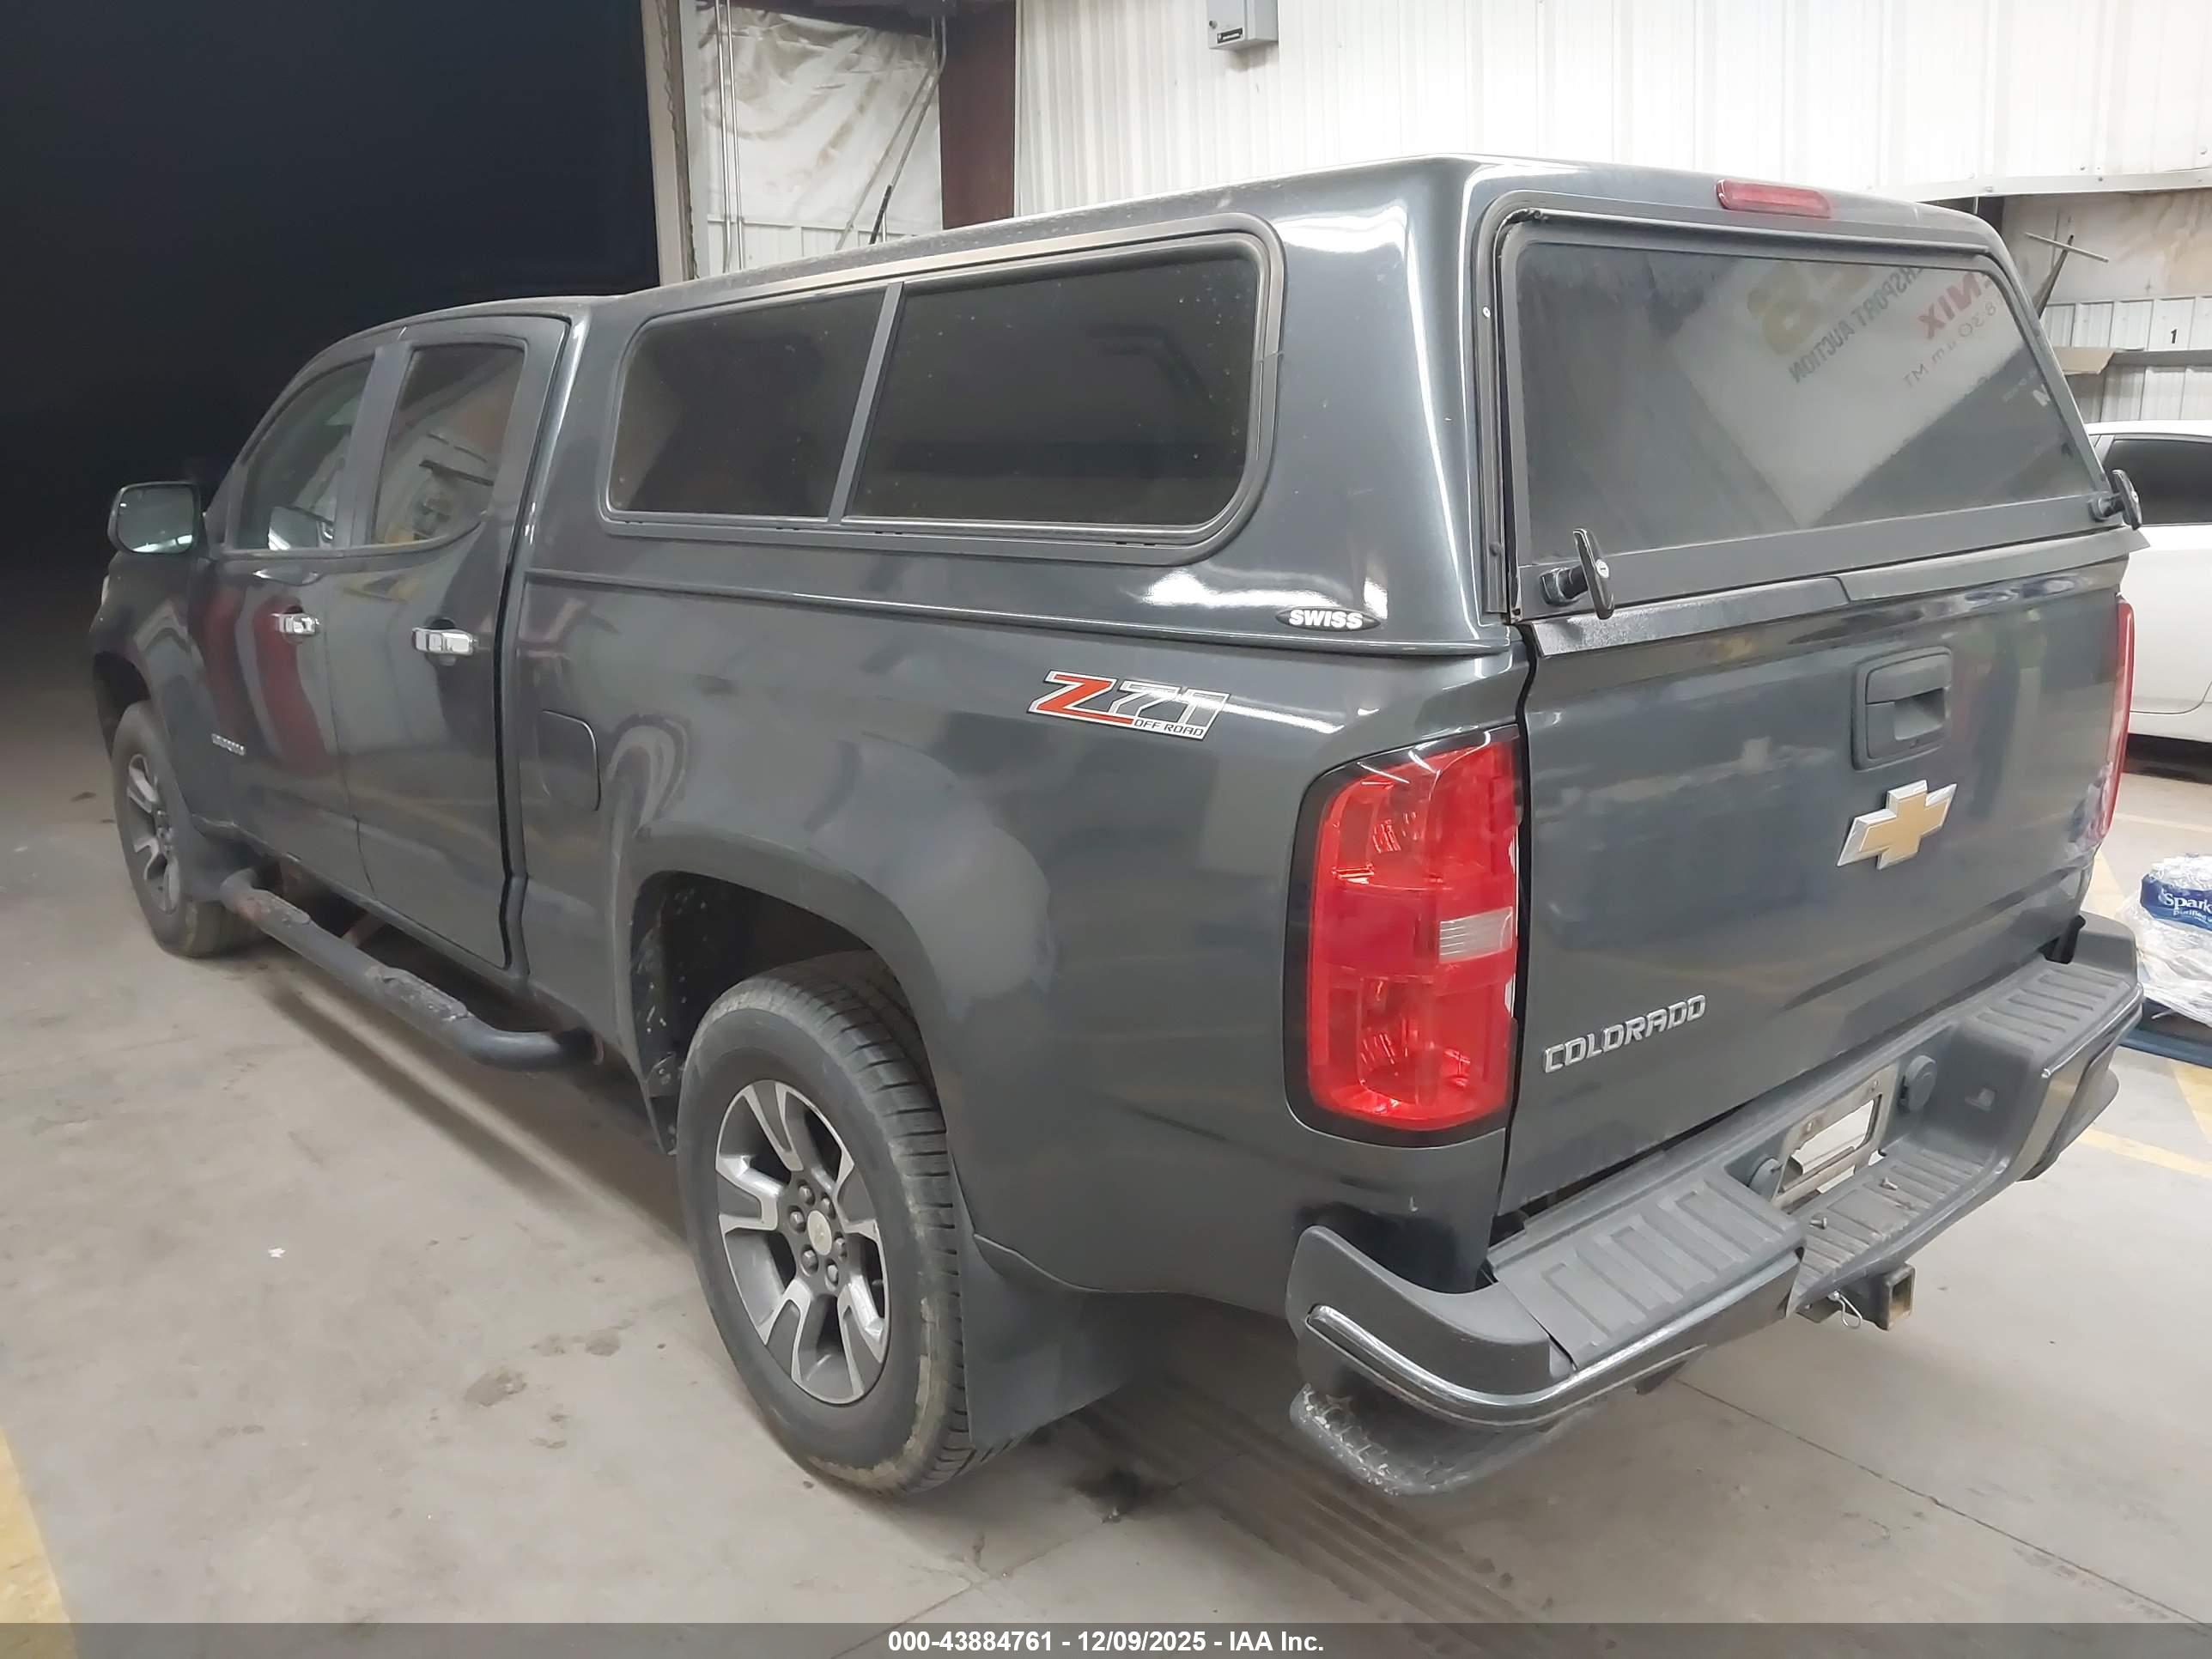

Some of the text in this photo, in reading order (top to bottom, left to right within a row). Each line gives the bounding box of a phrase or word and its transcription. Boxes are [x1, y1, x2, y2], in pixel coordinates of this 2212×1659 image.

[2171, 328, 2177, 344] 1
[1288, 609, 1364, 630] SWISS
[1027, 669, 1230, 732] Z71
[1133, 718, 1204, 738] OFF ROAD
[1545, 994, 1706, 1073] COLORADO
